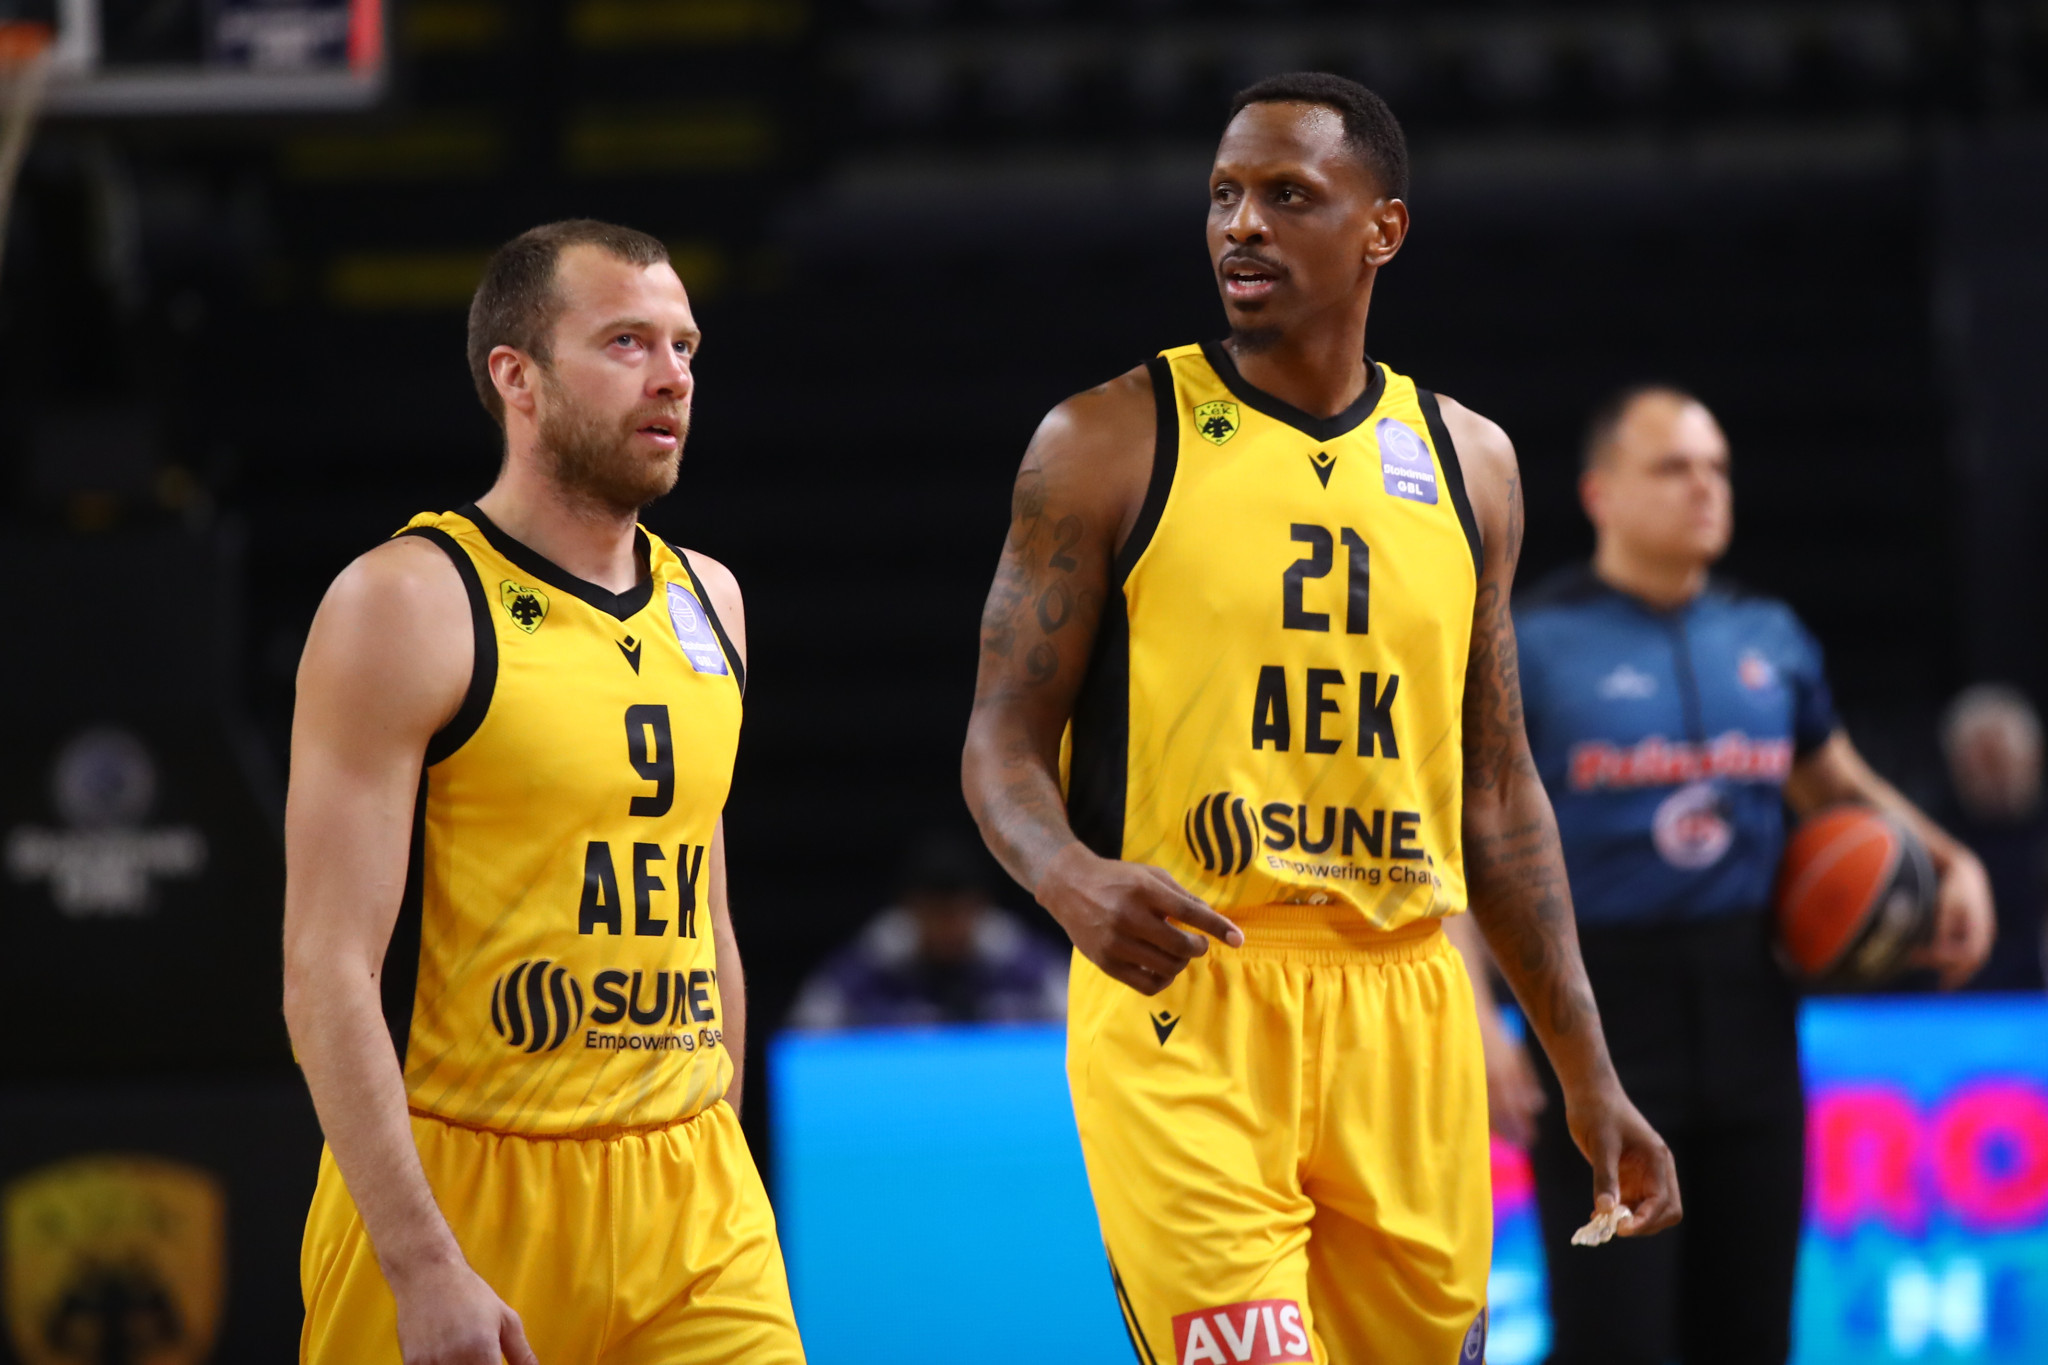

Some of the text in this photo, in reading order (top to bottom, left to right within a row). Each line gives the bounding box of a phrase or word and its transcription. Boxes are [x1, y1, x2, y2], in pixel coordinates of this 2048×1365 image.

[1282, 522, 1370, 635] 21
[1251, 665, 1400, 759] AEK
[624, 704, 675, 818] 9
[1261, 802, 1434, 867] SUNE
[578, 841, 705, 939] AEK
[590, 969, 716, 1026] SUNE
[1183, 1304, 1309, 1365] AVIS
